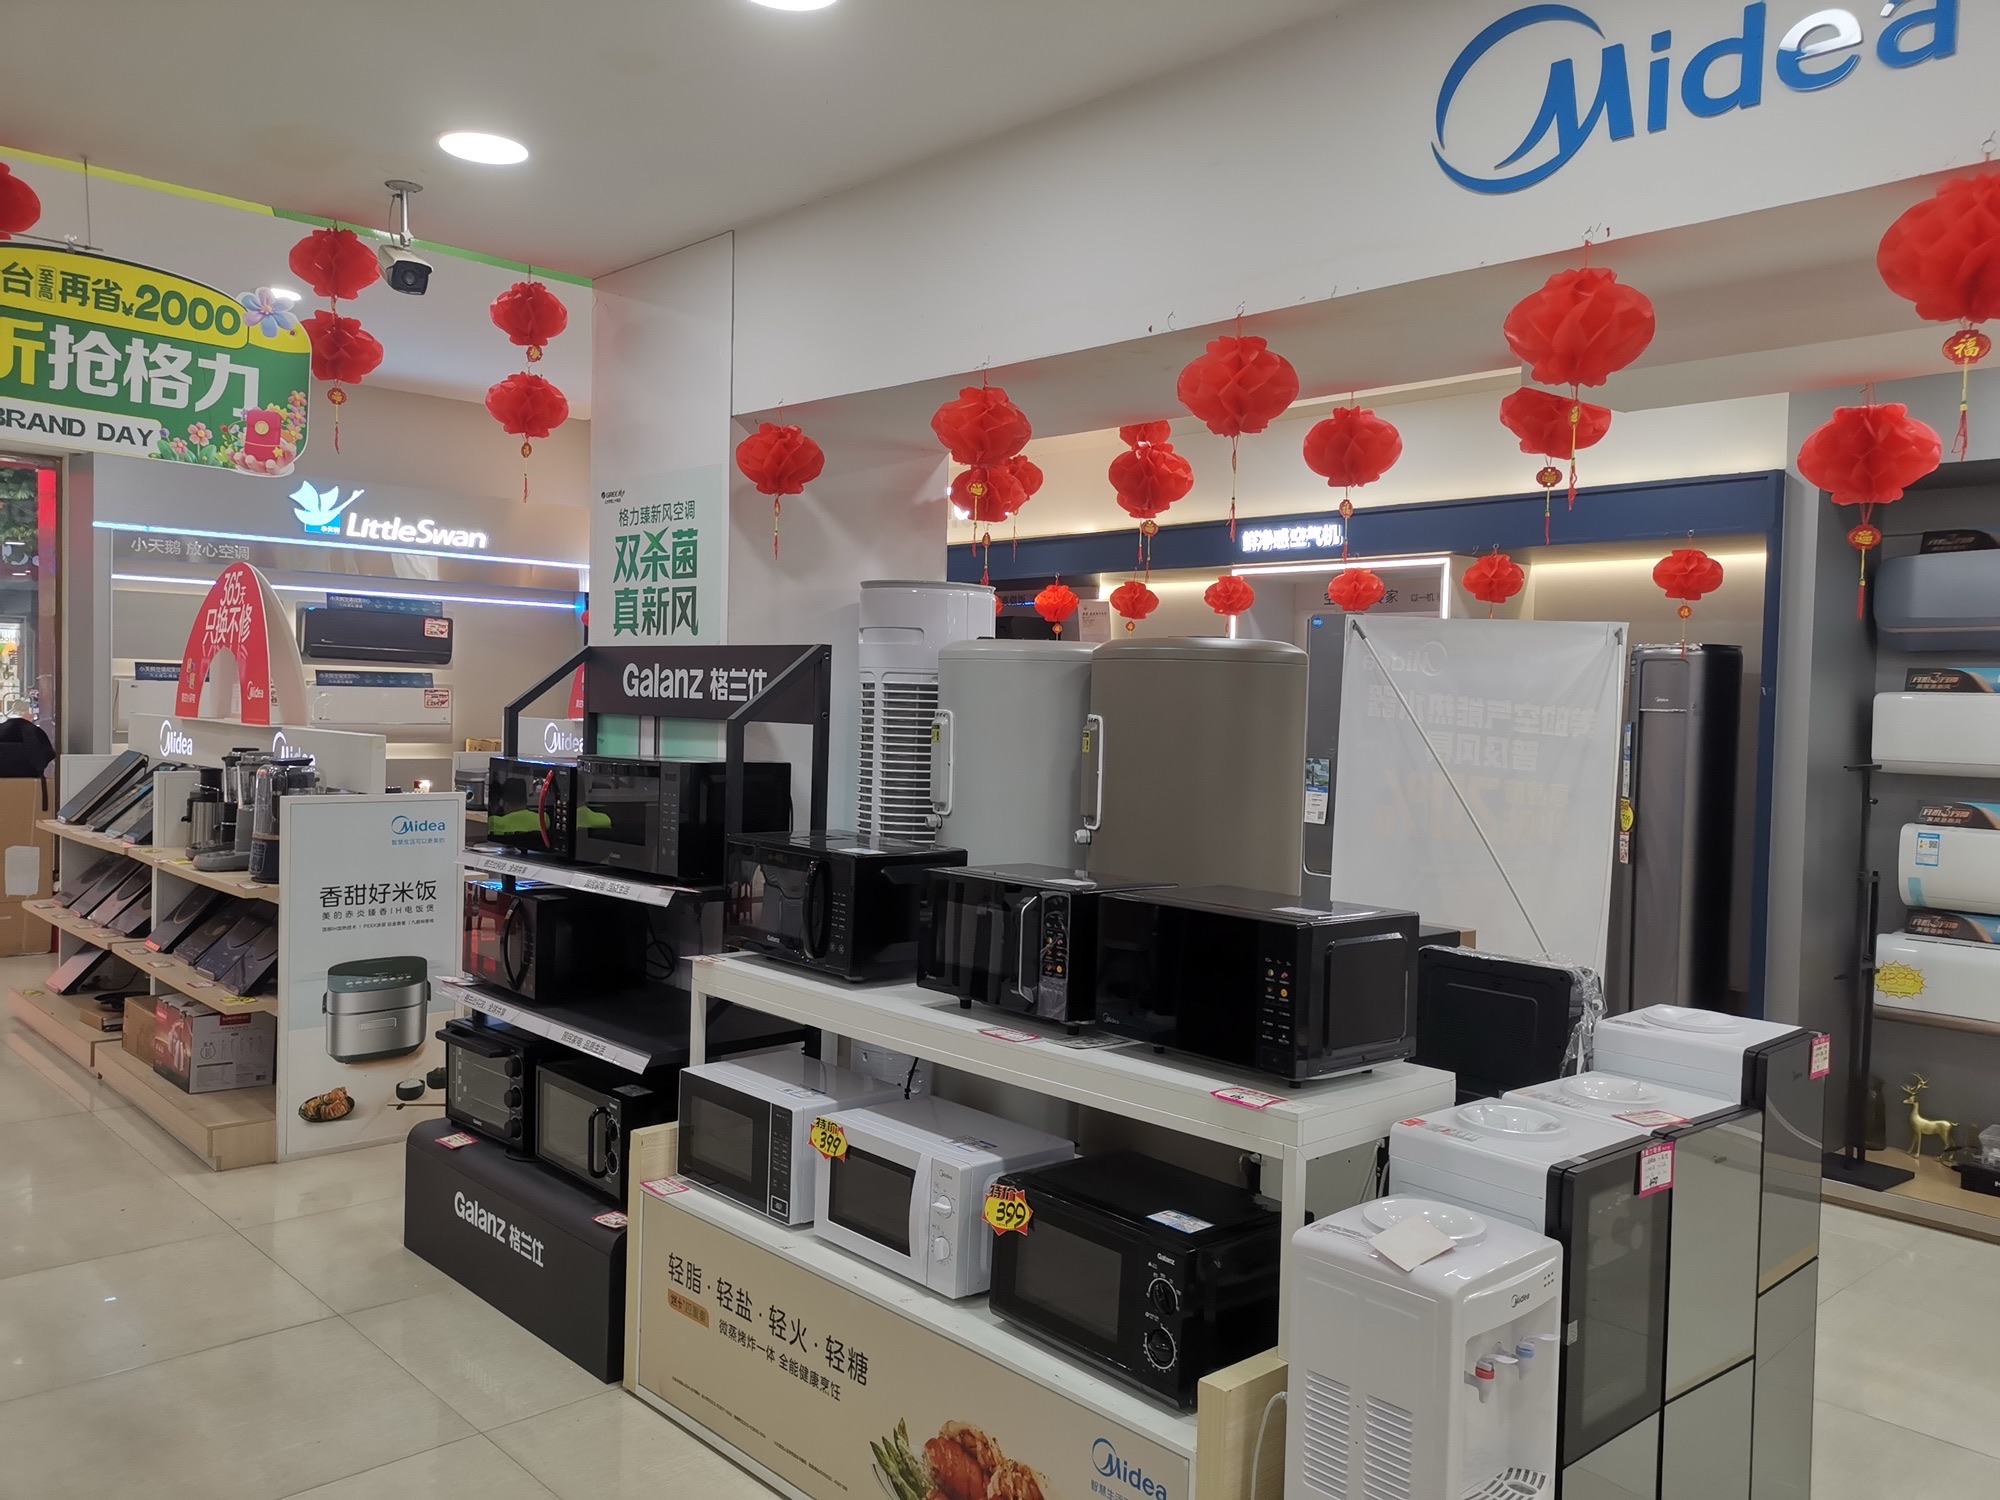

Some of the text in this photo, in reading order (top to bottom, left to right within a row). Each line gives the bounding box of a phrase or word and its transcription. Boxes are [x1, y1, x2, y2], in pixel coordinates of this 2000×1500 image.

[1431, 0, 1959, 194] Midea
[97, 421, 154, 447] DAY
[346, 512, 488, 549] LittleSwan
[618, 500, 696, 528] 格力臻新风空调
[130, 537, 251, 561] 小天鹅 放心空调
[613, 526, 699, 583] 双杀菌
[219, 570, 247, 607] 365天
[202, 604, 253, 644] 只换不修
[613, 586, 699, 637] 真新风
[246, 680, 265, 700] Midea
[622, 662, 768, 702] Galanz 格兰仕
[159, 719, 193, 757] Midea
[391, 815, 446, 835] Midea
[319, 880, 437, 908] 香甜好米饭
[815, 1117, 841, 1136] 特价
[820, 1131, 842, 1157] 399
[989, 1185, 1017, 1202] 特价
[454, 1190, 544, 1268] Galanz 格兰仕
[996, 1202, 1026, 1228] 399
[718, 1318, 842, 1402] 微蒸烤炸一体 全能健康烹饪
[1091, 1437, 1168, 1500] Midea
